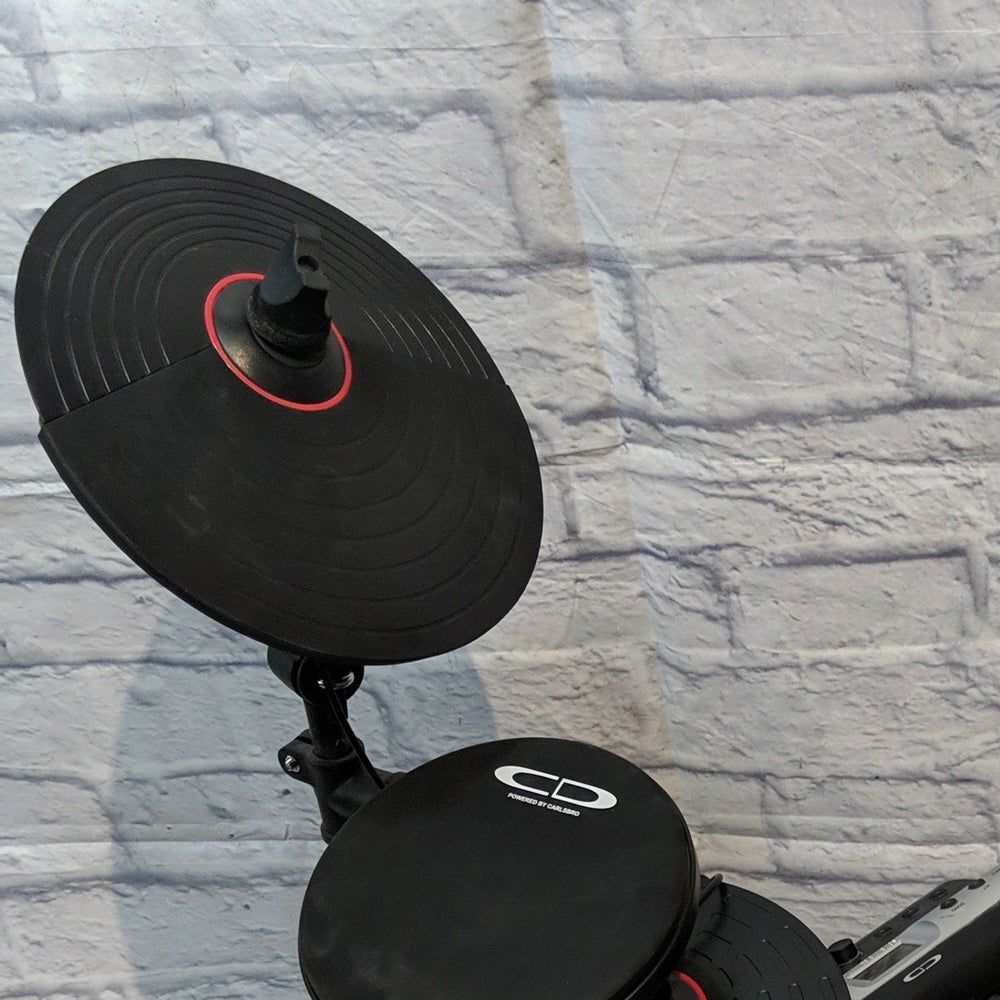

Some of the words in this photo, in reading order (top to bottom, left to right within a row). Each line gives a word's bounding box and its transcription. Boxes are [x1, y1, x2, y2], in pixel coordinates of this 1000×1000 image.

[494, 765, 617, 810] CD
[507, 792, 538, 805] POWERED
[537, 800, 548, 808] BY
[547, 803, 580, 817] CARLSBRO
